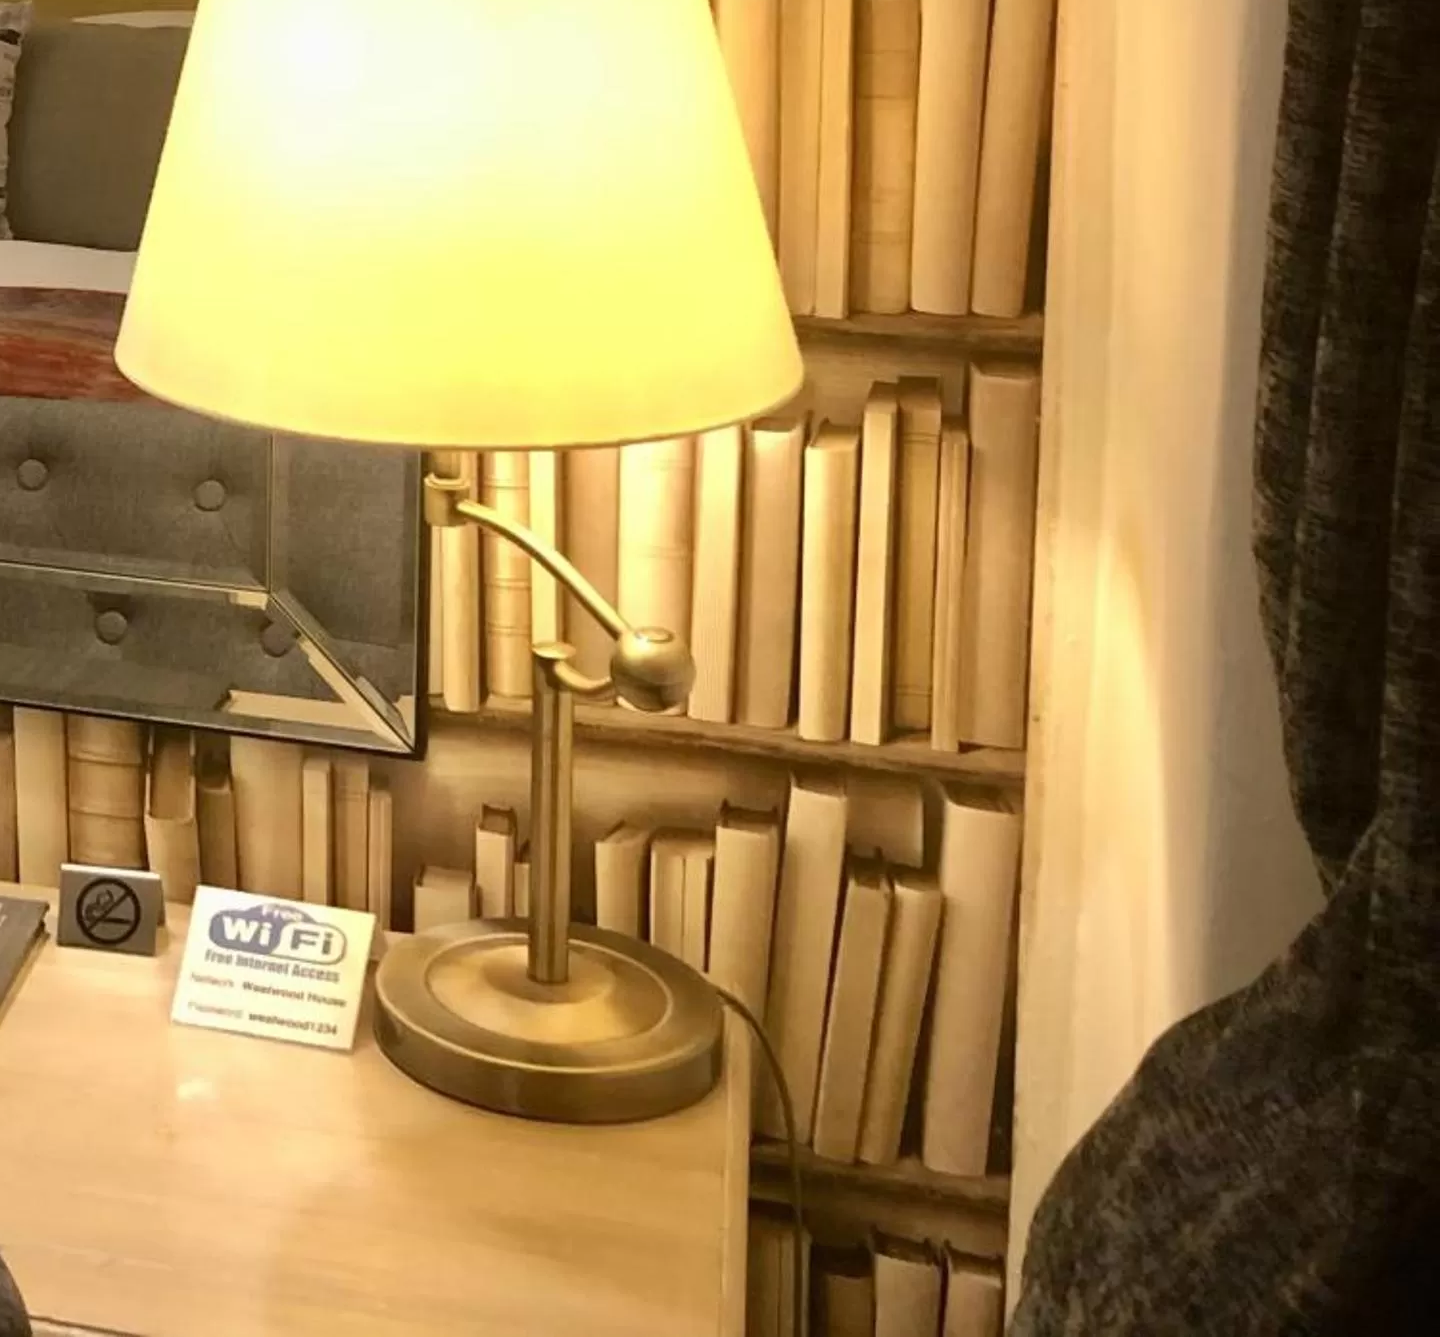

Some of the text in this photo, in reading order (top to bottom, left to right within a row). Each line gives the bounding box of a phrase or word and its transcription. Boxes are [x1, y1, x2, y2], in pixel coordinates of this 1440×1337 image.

[204, 949, 340, 983] Free Internet Access
